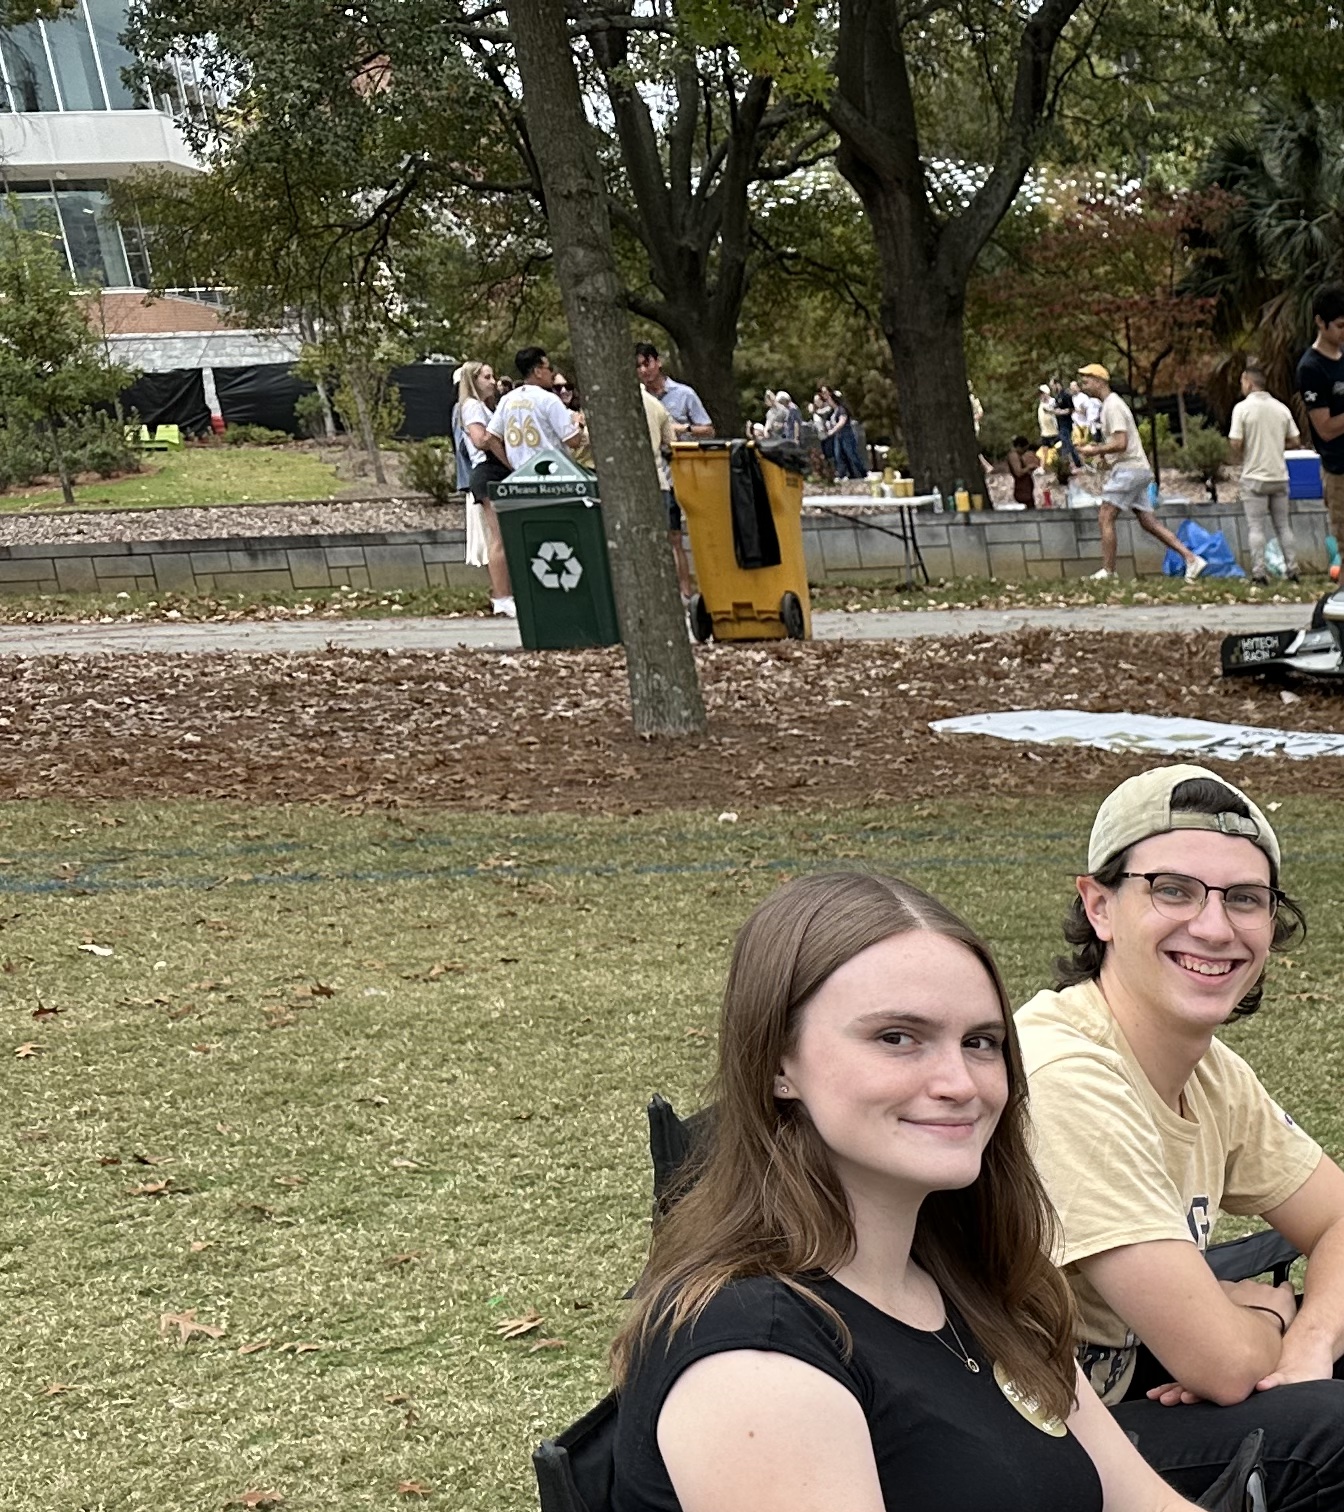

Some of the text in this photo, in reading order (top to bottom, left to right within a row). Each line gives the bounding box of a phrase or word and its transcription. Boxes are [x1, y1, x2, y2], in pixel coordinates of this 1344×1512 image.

[507, 415, 541, 448] 66
[509, 483, 575, 495] Please Recycle
